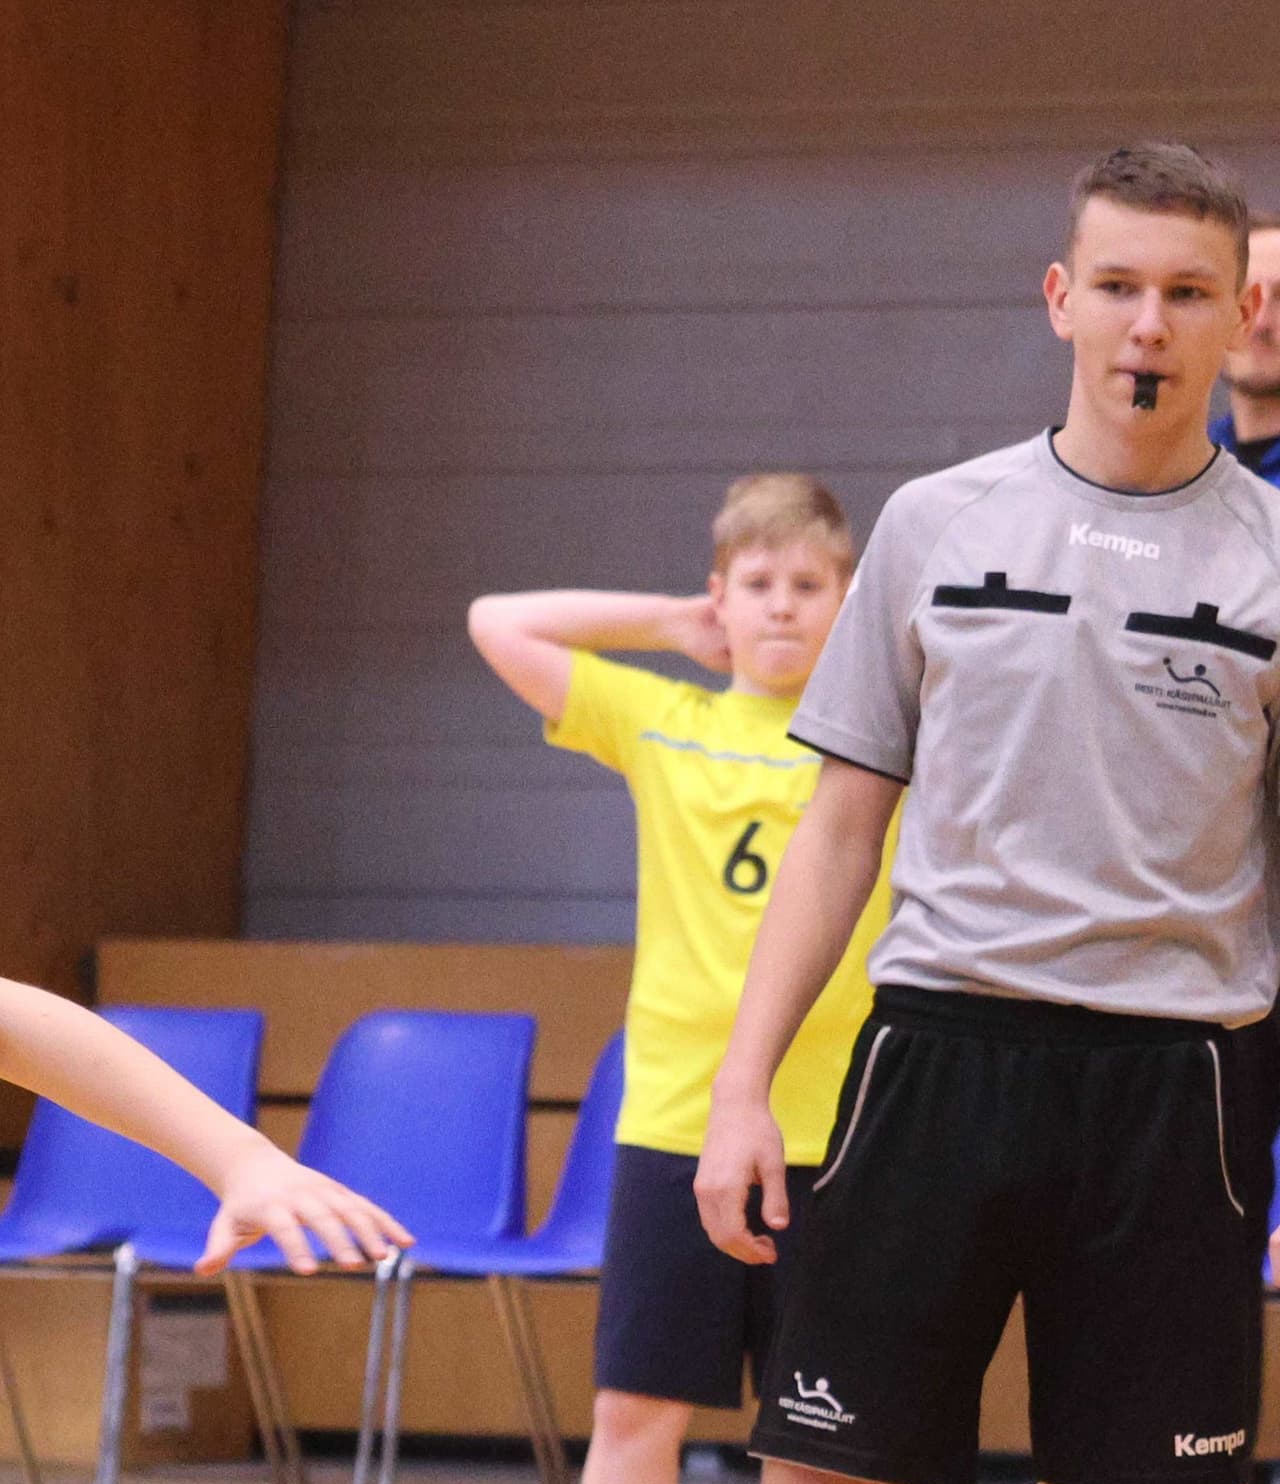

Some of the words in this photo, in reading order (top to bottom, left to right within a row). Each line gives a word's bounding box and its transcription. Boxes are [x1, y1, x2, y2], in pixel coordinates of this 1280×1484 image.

[1068, 522, 1161, 561] Kempa
[723, 820, 768, 895] 6
[1174, 1428, 1246, 1457] Kempa
